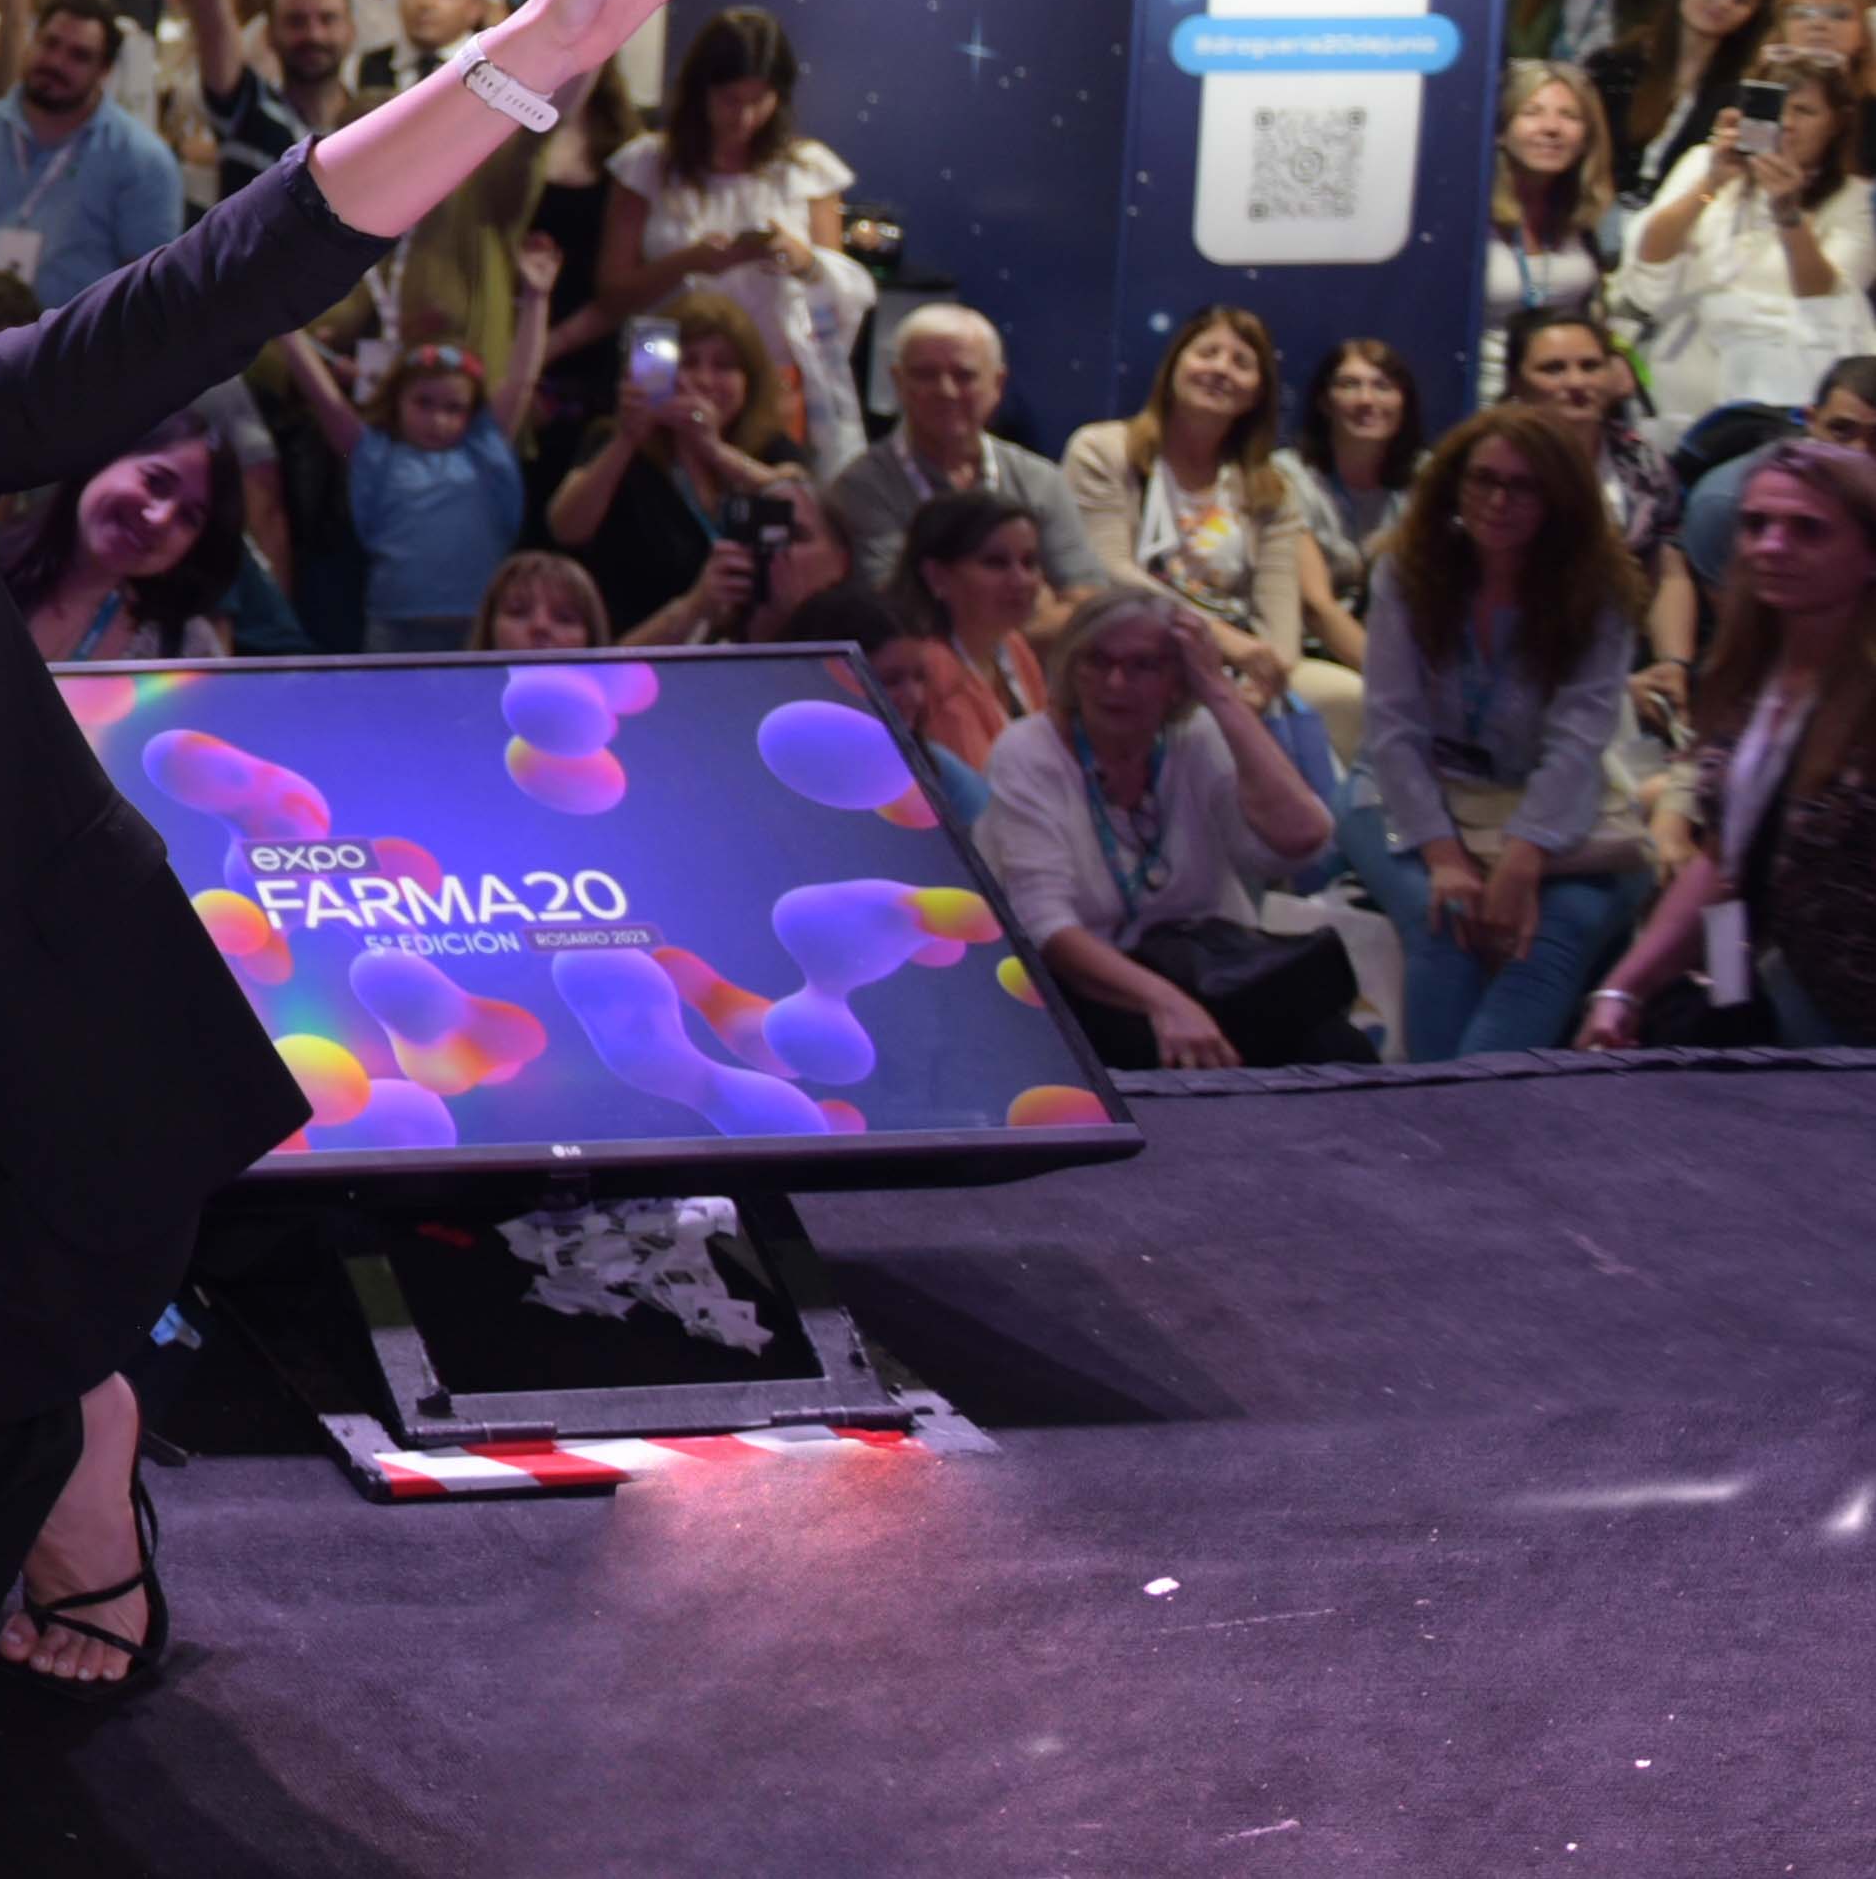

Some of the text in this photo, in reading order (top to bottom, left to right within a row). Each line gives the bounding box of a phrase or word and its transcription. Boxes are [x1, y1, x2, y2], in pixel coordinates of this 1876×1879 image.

[250, 843, 367, 873] expo
[254, 869, 629, 930] FARMA20
[400, 929, 521, 957] EDICIÓN
[534, 931, 609, 947] ROSARIO
[612, 930, 650, 946] 2023
